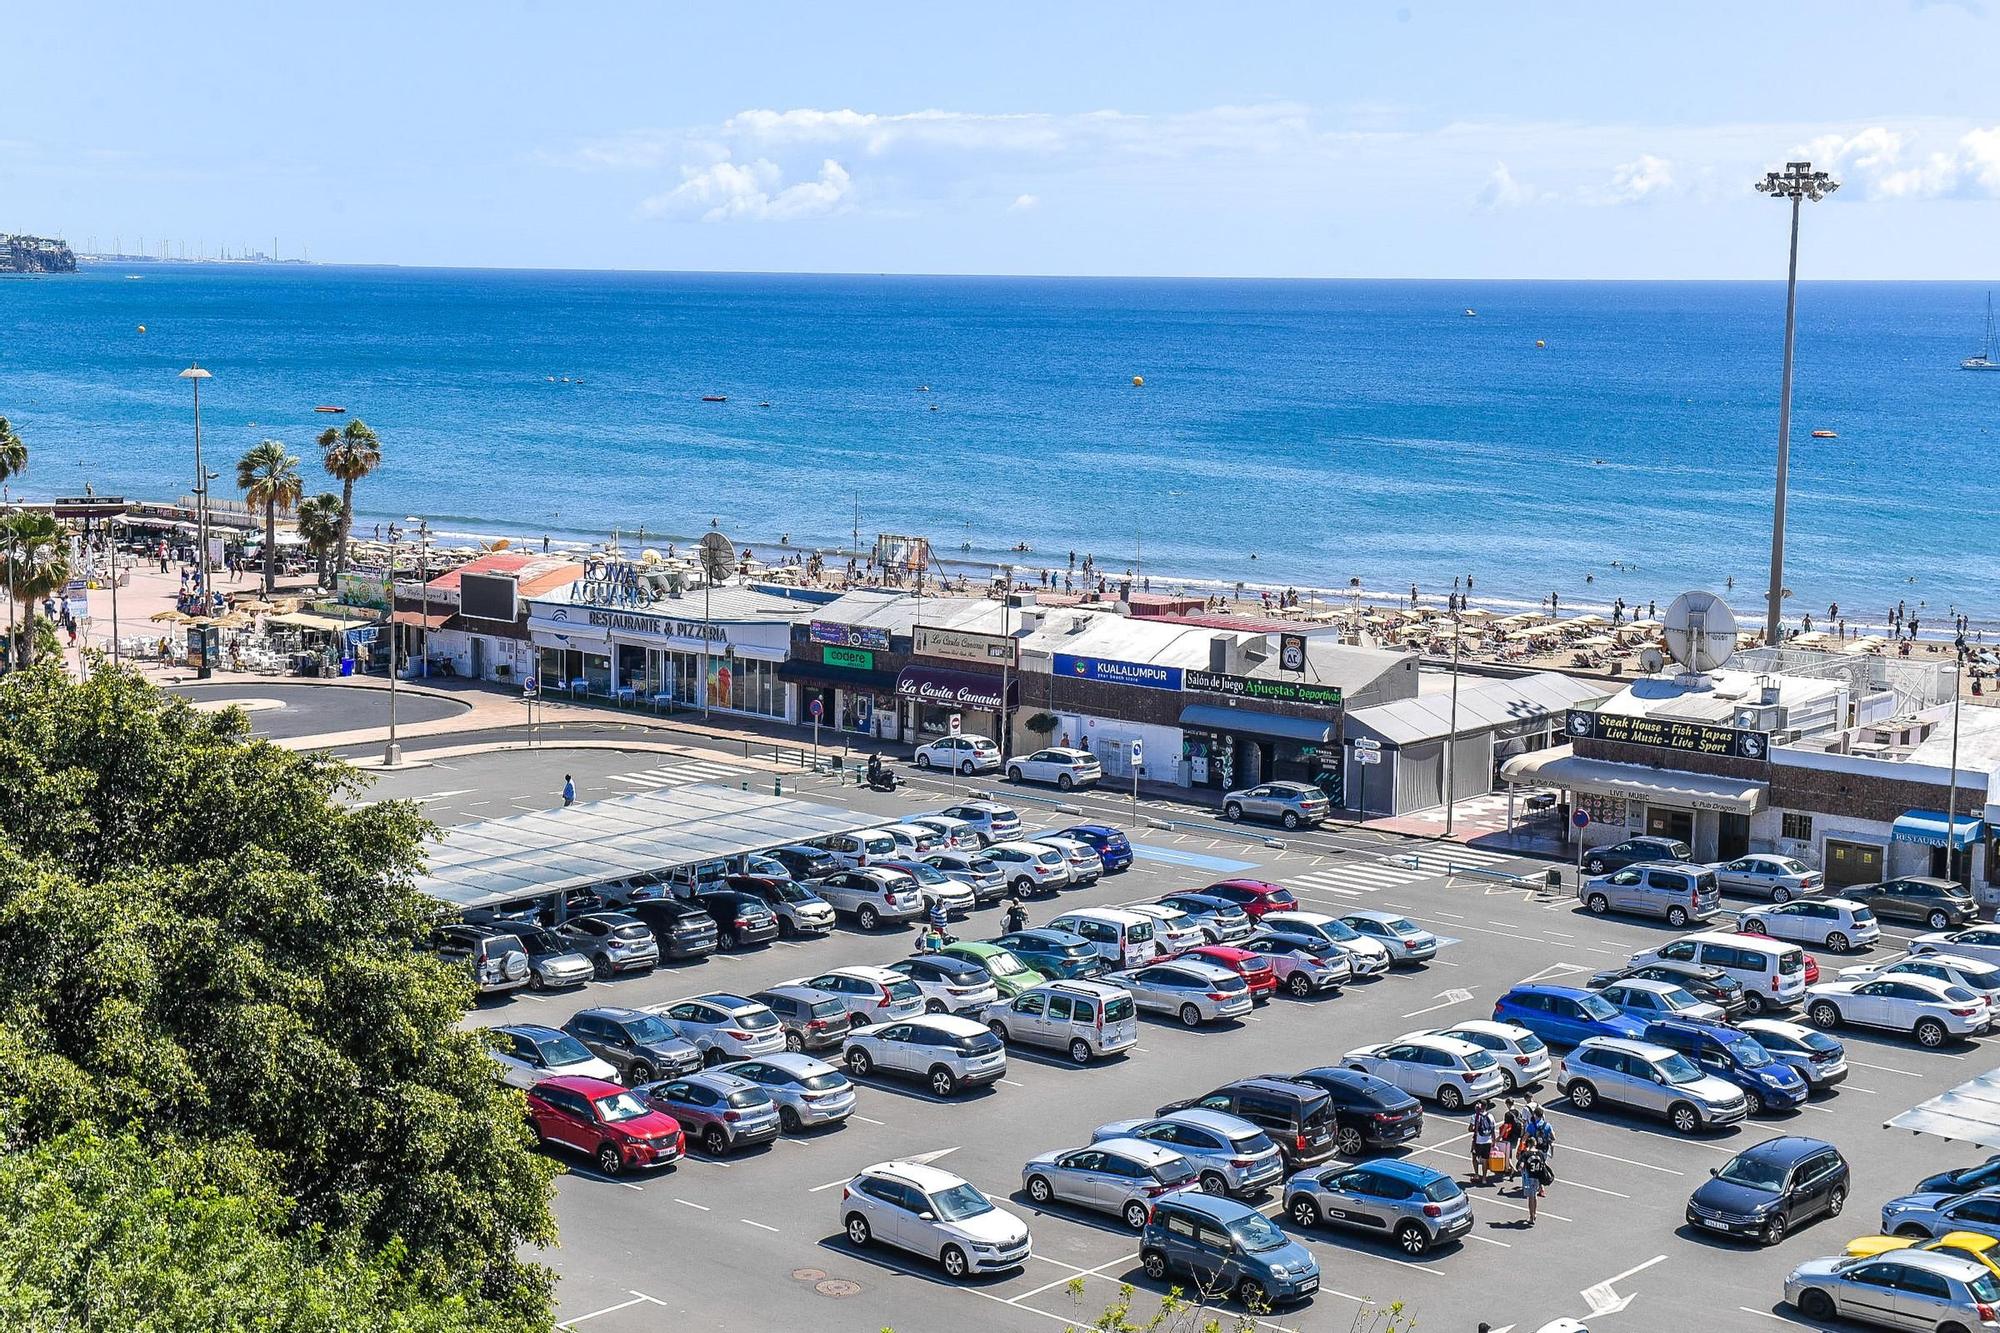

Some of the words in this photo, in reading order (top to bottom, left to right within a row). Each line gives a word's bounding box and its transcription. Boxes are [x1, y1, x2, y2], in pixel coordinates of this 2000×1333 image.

[584, 560, 638, 584] ROMA
[570, 580, 651, 609] ACUARIO
[589, 611, 660, 634] RESTAURANTE
[664, 622, 674, 636] &
[832, 651, 865, 664] codere
[1097, 663, 1167, 681] KUALALUMPUR
[899, 680, 917, 694] La
[920, 682, 954, 699] Casita
[957, 687, 1003, 706] Canaria
[1187, 672, 1209, 686] Salón
[1211, 676, 1220, 687] de
[1220, 678, 1244, 694] Juego
[1245, 681, 1295, 697] Apuestas
[1299, 688, 1341, 702] Deportivas
[1599, 715, 1629, 728] Steak
[1631, 719, 1661, 732] House
[1671, 724, 1692, 736] Fish
[1701, 727, 1732, 741] Tapas
[1606, 727, 1627, 740] Live
[1631, 731, 1662, 744] Music
[1671, 736, 1694, 748] Live
[1698, 739, 1727, 753] Sport
[1548, 780, 1571, 790] Dragon
[1609, 789, 1623, 798] LIVE
[1628, 791, 1650, 800] MUSIC
[1712, 803, 1737, 812] Dragon
[1896, 833, 1960, 849] RESTAURANE
